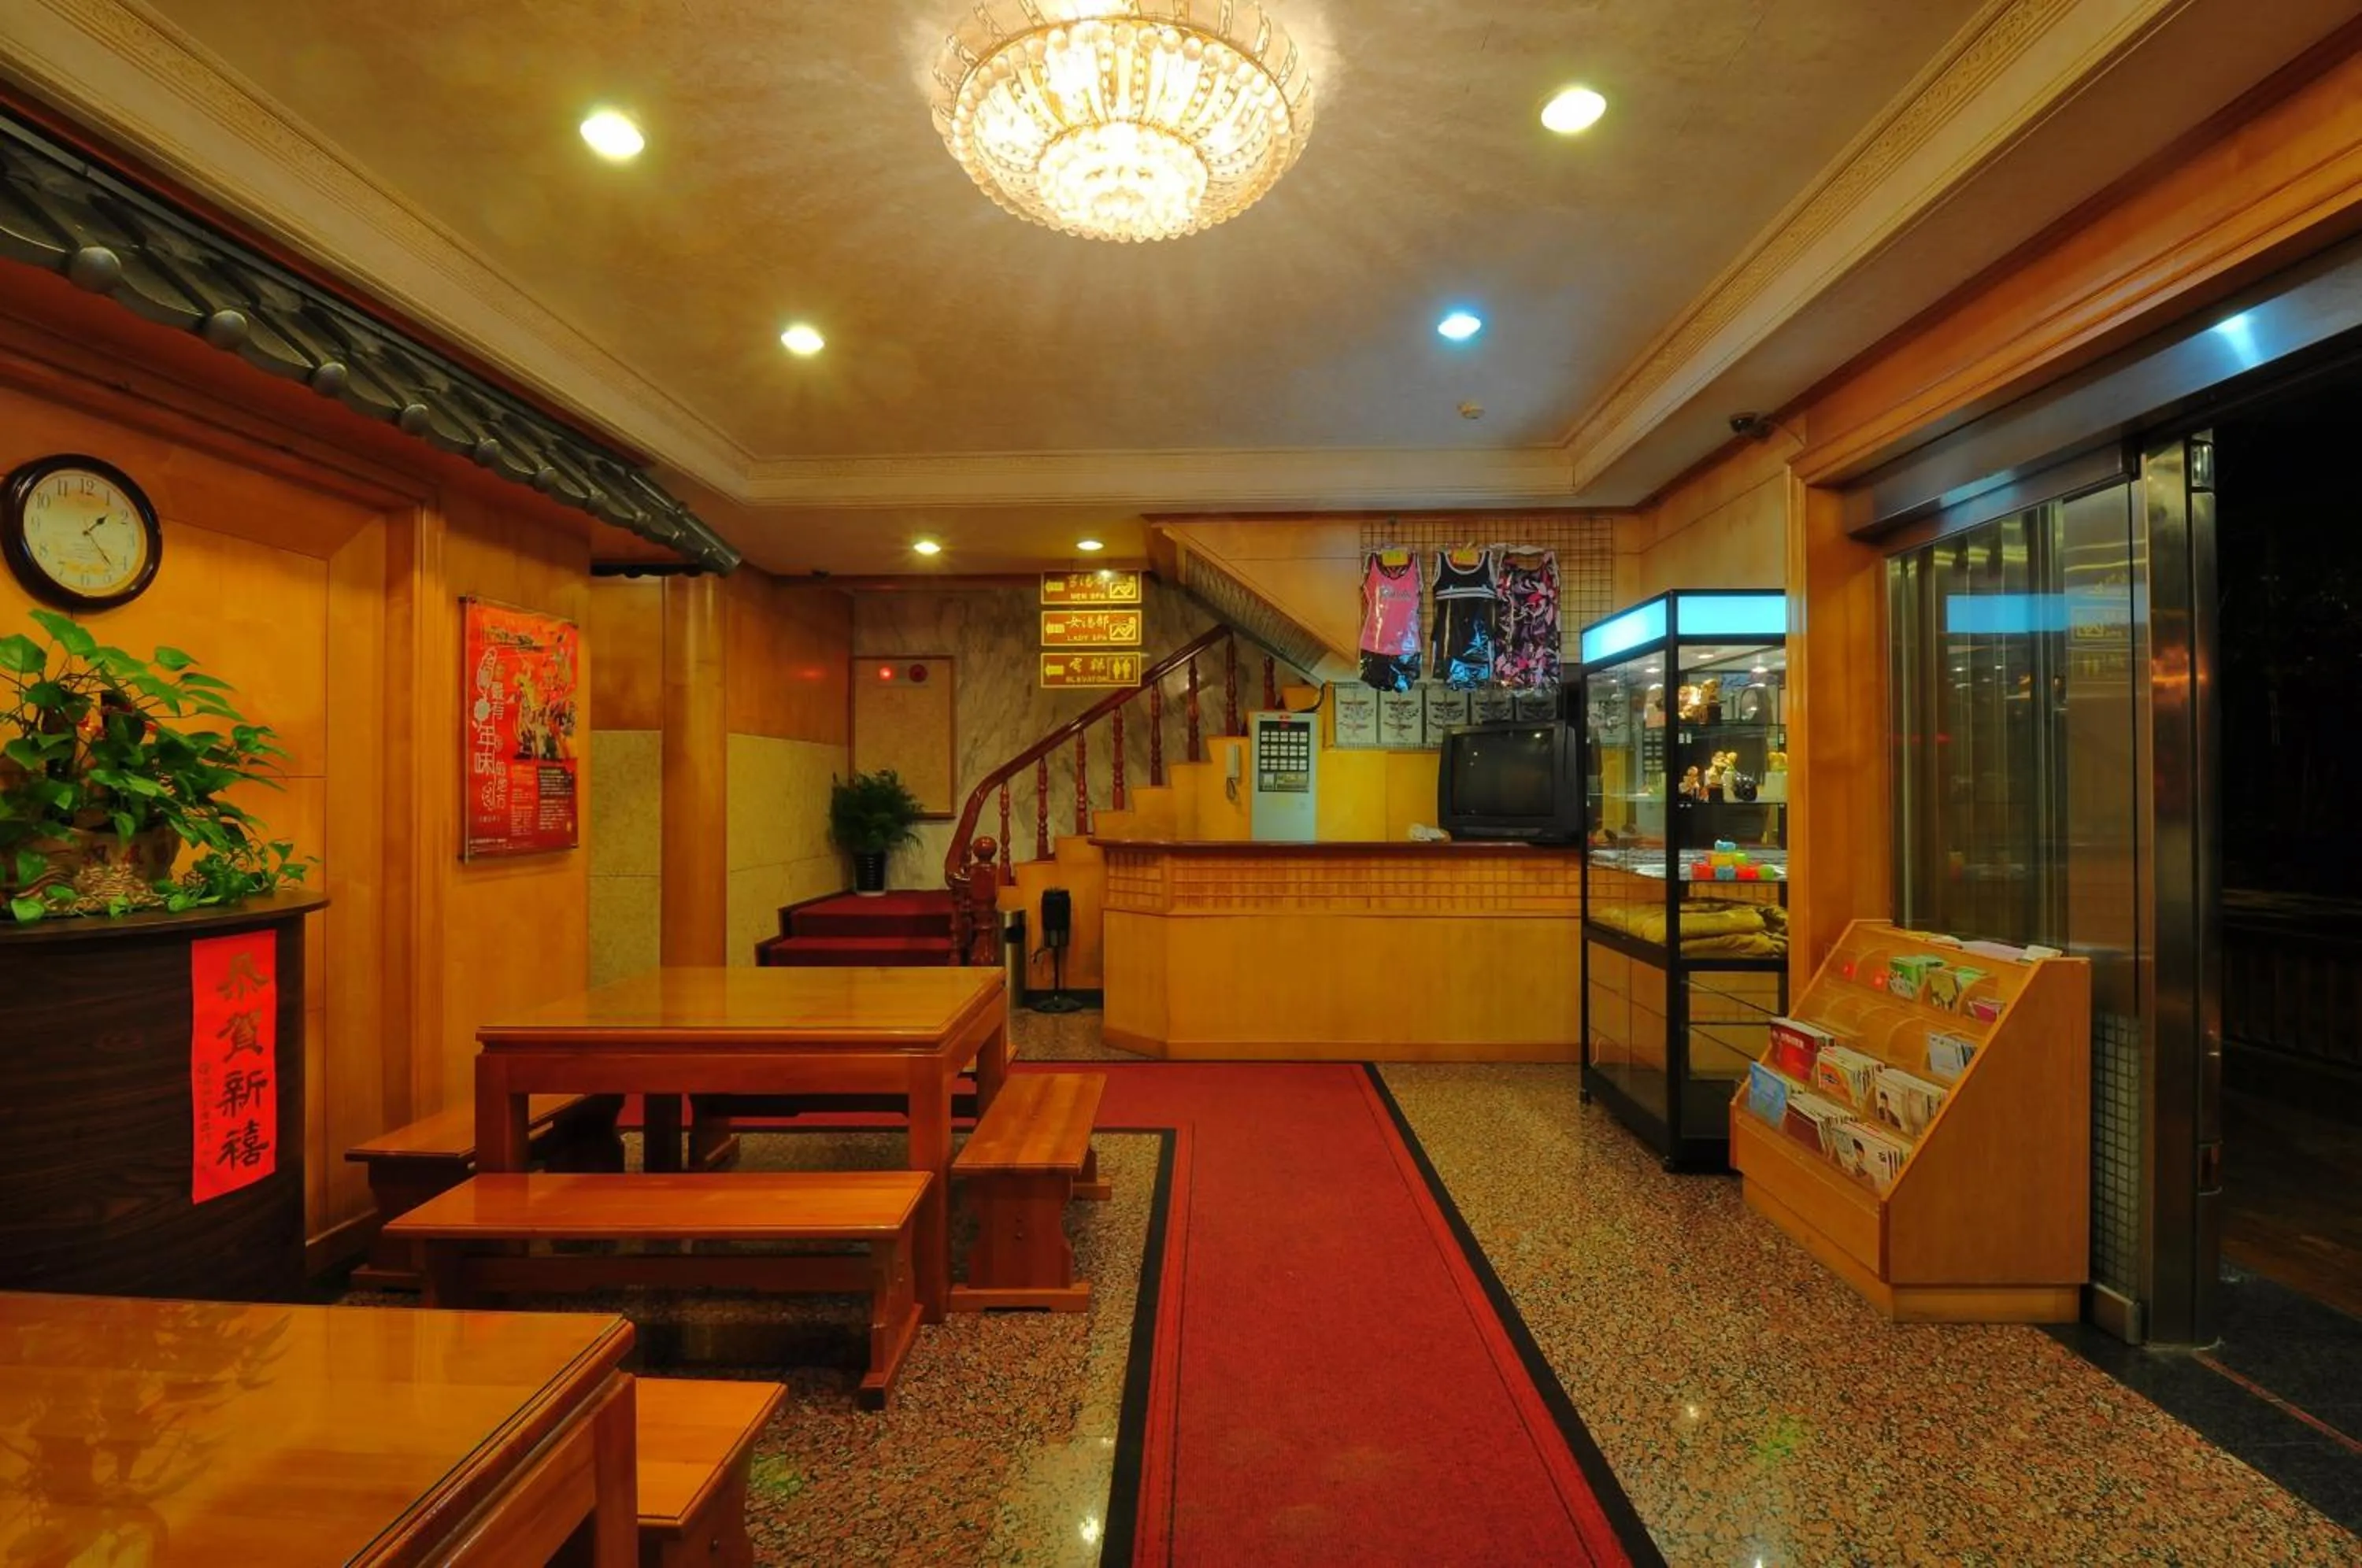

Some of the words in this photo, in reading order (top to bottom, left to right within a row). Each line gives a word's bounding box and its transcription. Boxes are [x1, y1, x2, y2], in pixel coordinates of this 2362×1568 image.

[57, 479, 68, 497] 11
[80, 478, 94, 497] 12
[36, 491, 50, 509] 10
[120, 510, 128, 525] 2
[57, 561, 66, 576] 7
[216, 951, 269, 1171] 恭賀新禧
